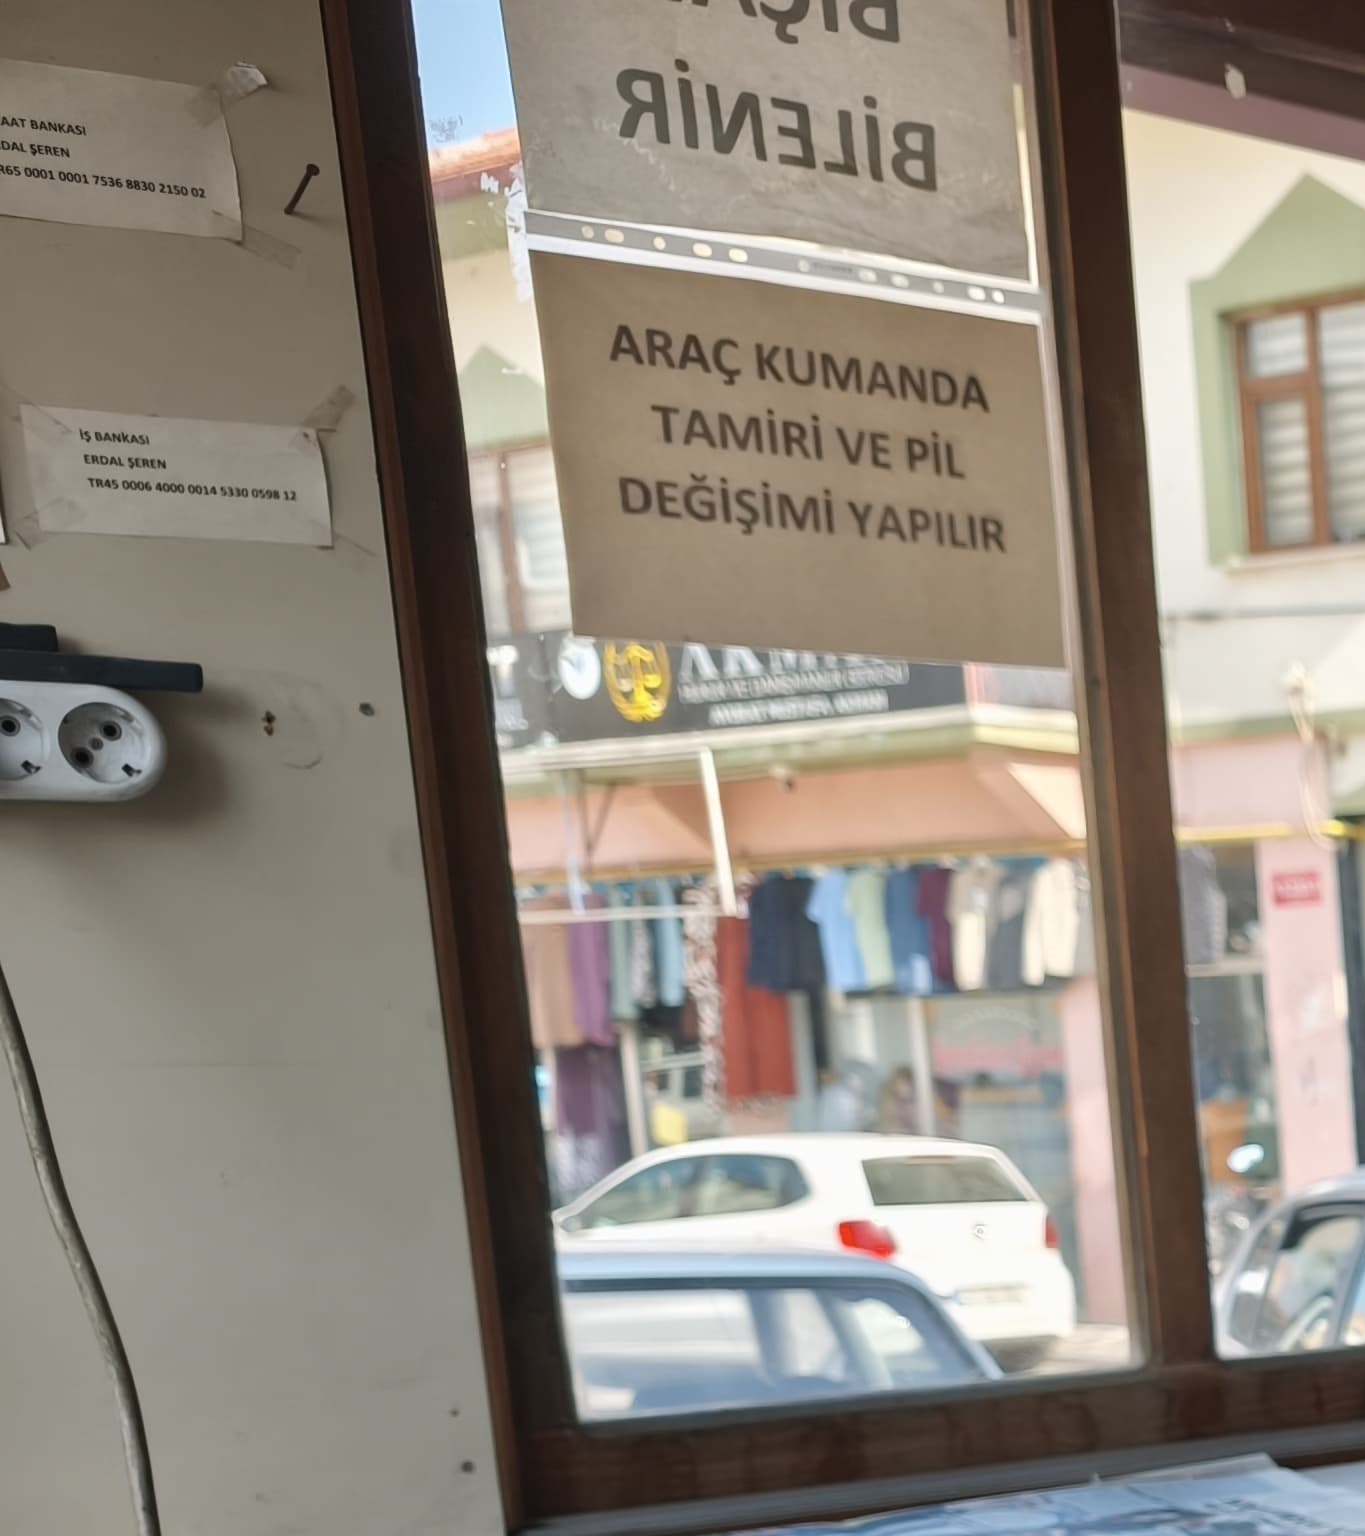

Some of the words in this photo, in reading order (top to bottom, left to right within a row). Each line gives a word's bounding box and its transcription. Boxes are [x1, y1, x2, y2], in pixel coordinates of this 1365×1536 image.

[30, 119, 87, 136] BANKASI
[0, 140, 27, 153] DAL
[29, 143, 71, 158] ŞEREN
[24, 167, 55, 180] 0001
[58, 171, 89, 184] 0001
[92, 175, 123, 188] 7536
[126, 178, 156, 192] 8830
[159, 183, 189, 196] 2150
[191, 187, 207, 198] 02
[609, 324, 742, 386] ARAÇ
[755, 342, 991, 414] KUMANDA
[94, 431, 150, 445] BANKASI
[651, 404, 824, 461] TAMİRİ
[836, 425, 893, 471] VE
[905, 430, 967, 480] PİL
[84, 453, 125, 467] ERDAL
[127, 456, 167, 470] ŞEREN
[87, 477, 120, 490] TR45
[121, 479, 153, 492] 0006
[155, 482, 185, 494] 4000
[187, 484, 217, 496] 0014
[283, 490, 297, 502] 12
[618, 472, 836, 536] DEĞİŞİMİ
[847, 499, 1008, 554] YAPILIR
